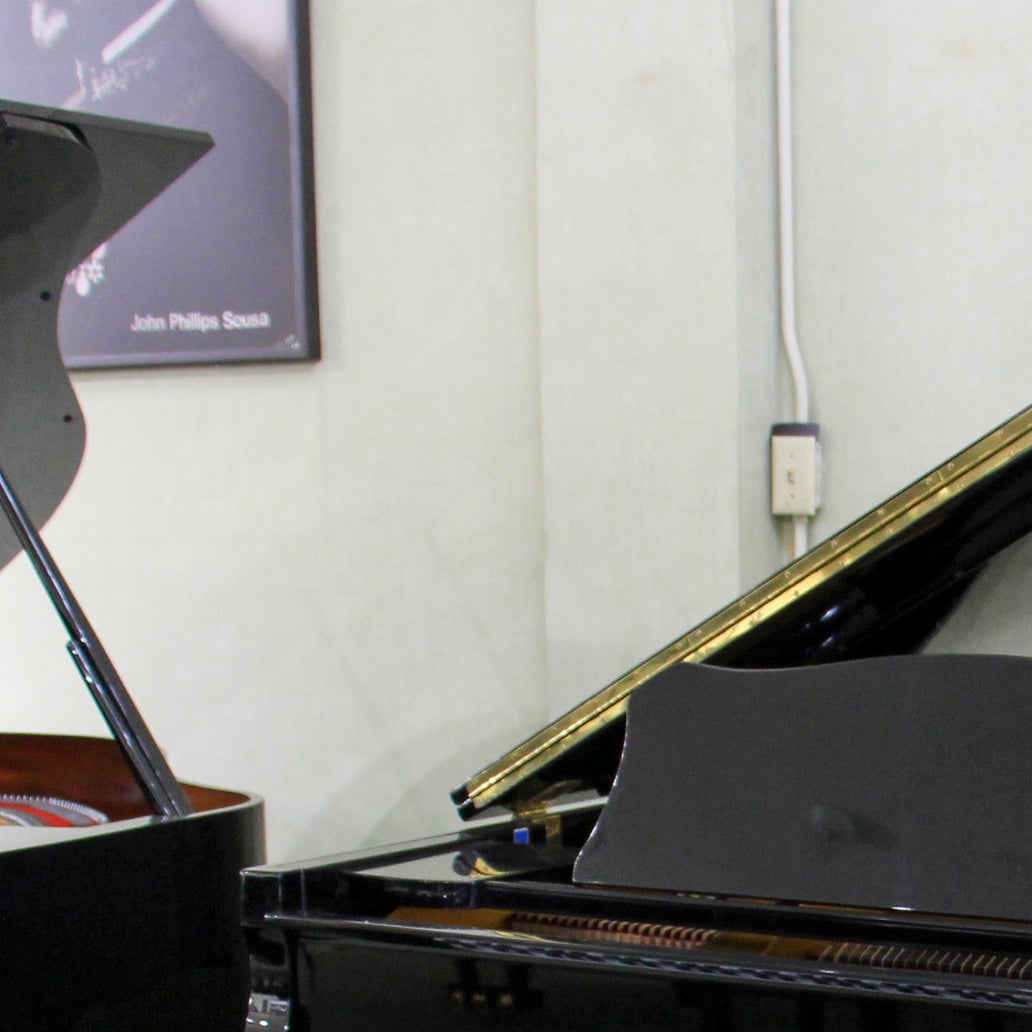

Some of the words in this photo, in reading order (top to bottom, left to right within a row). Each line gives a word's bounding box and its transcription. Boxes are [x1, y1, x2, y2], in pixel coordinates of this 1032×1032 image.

[131, 314, 166, 332] John
[168, 312, 219, 333] Phillips
[221, 310, 270, 330] Sousa
